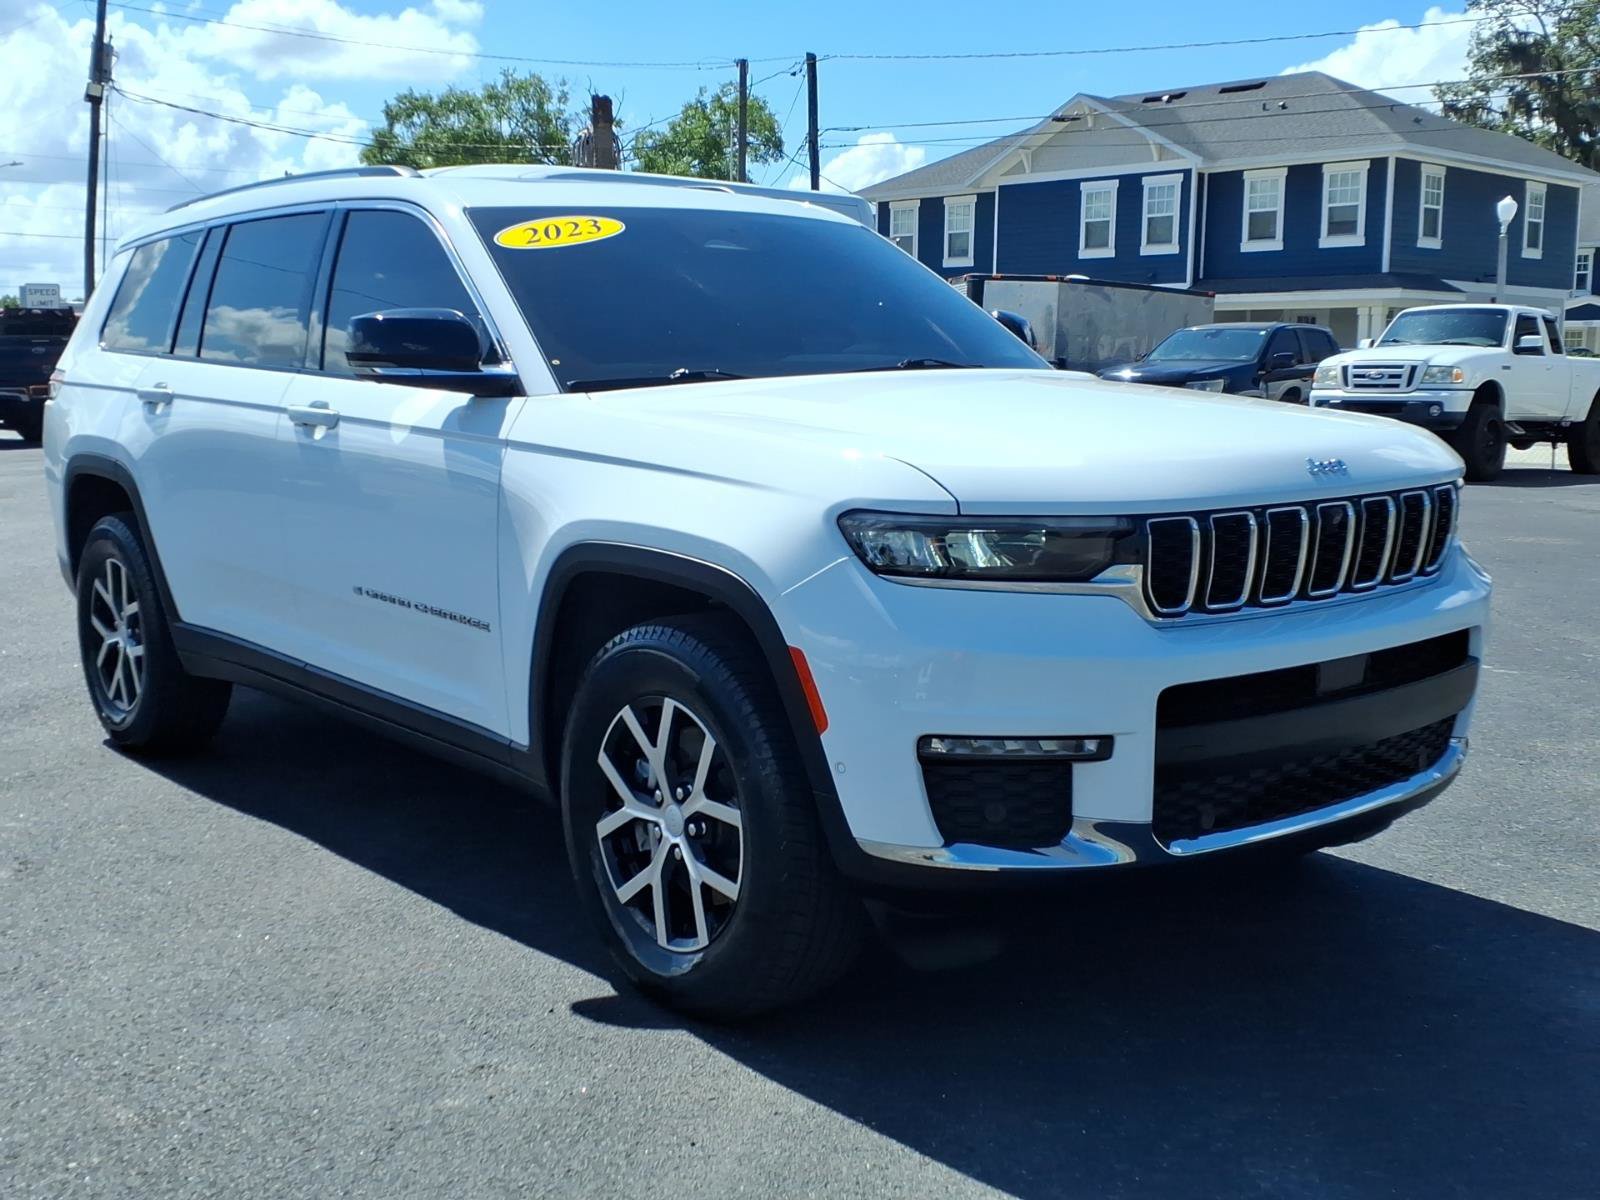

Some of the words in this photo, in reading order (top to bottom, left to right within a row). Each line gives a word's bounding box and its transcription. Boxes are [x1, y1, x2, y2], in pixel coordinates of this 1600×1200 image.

[523, 219, 602, 244] 2023
[28, 288, 57, 296] SPEED
[413, 601, 492, 633] CHEROKEE
